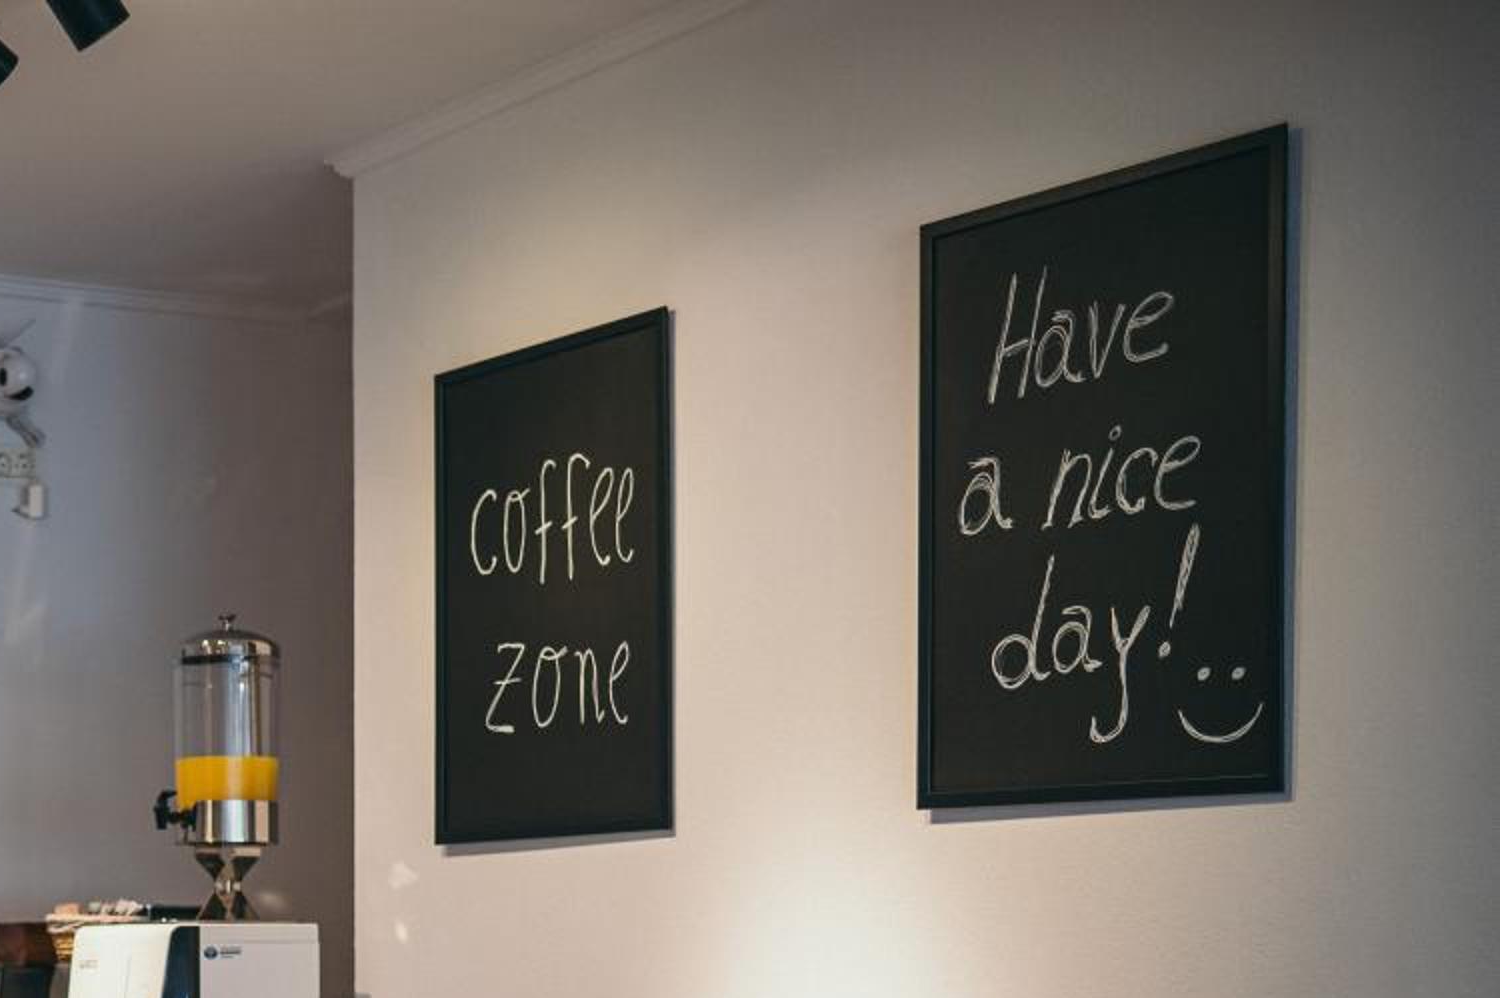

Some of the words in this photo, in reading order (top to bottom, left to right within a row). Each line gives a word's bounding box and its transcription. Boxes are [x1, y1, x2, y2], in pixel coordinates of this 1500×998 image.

[988, 265, 1174, 405] Have
[470, 453, 635, 585] coffee
[958, 455, 1013, 536] a
[1042, 424, 1202, 530] nice
[485, 640, 631, 733] zone
[990, 523, 1201, 743] day!
